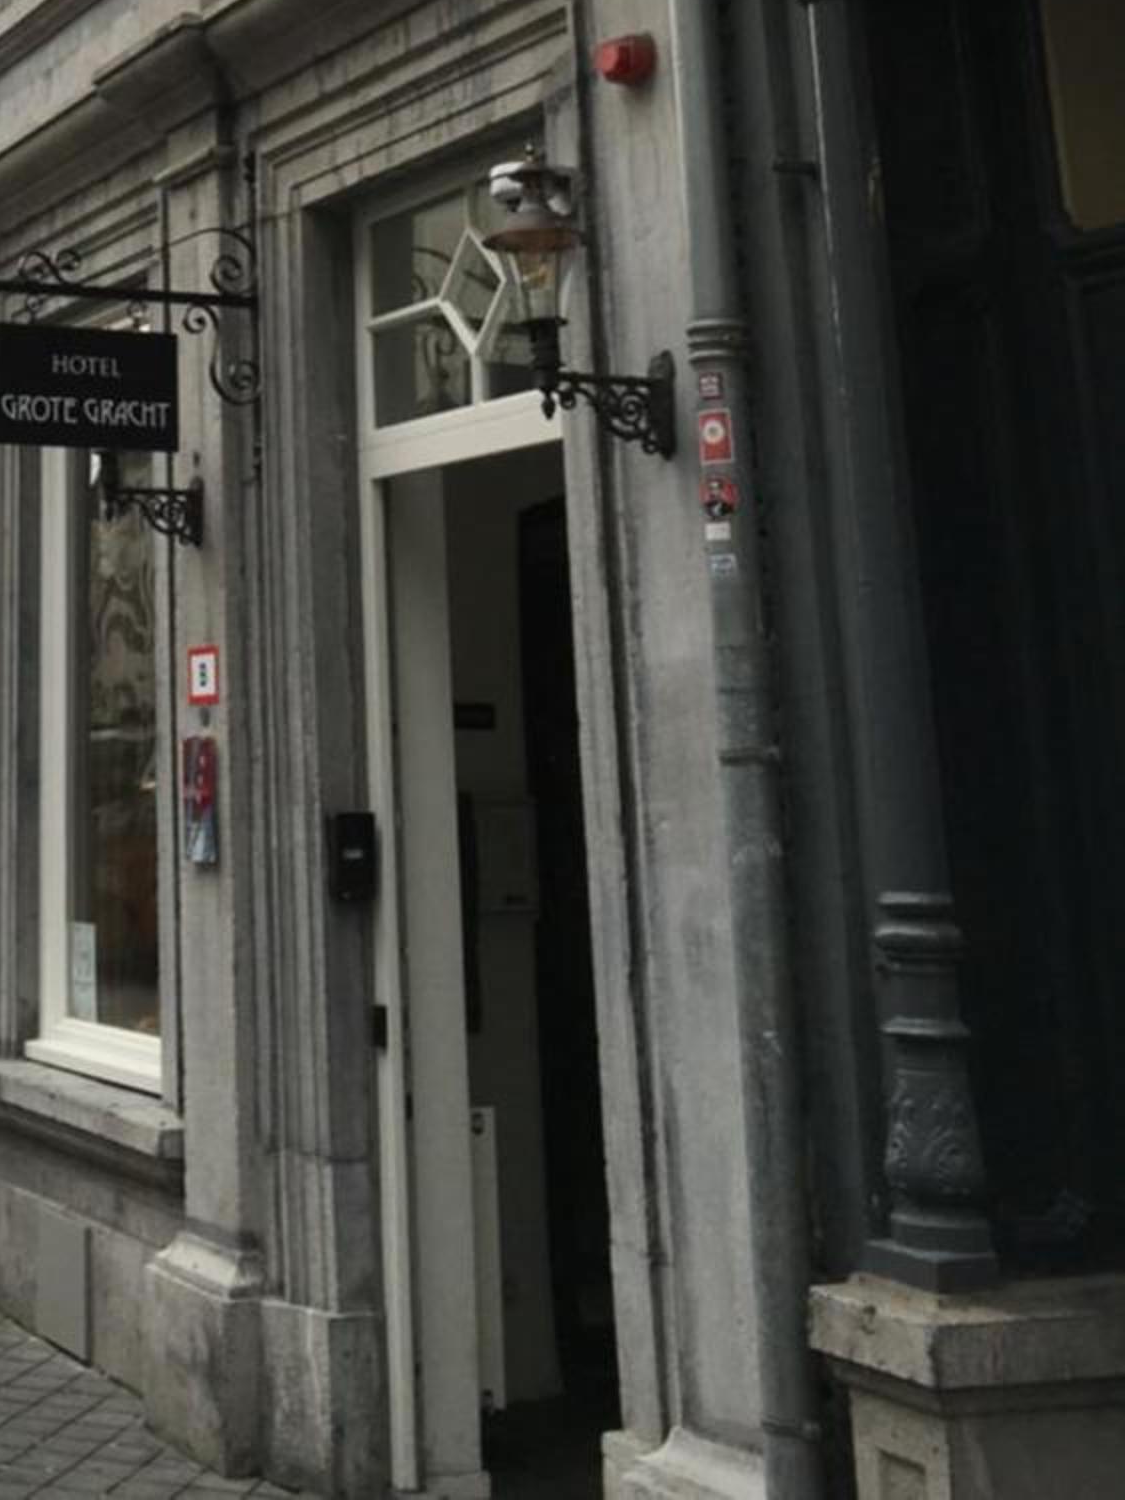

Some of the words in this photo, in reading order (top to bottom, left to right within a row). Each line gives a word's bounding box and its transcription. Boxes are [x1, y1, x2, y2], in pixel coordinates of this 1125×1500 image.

[52, 355, 121, 377] HOTEL
[2, 395, 78, 424] GROTE
[84, 399, 171, 429] GRACHT
